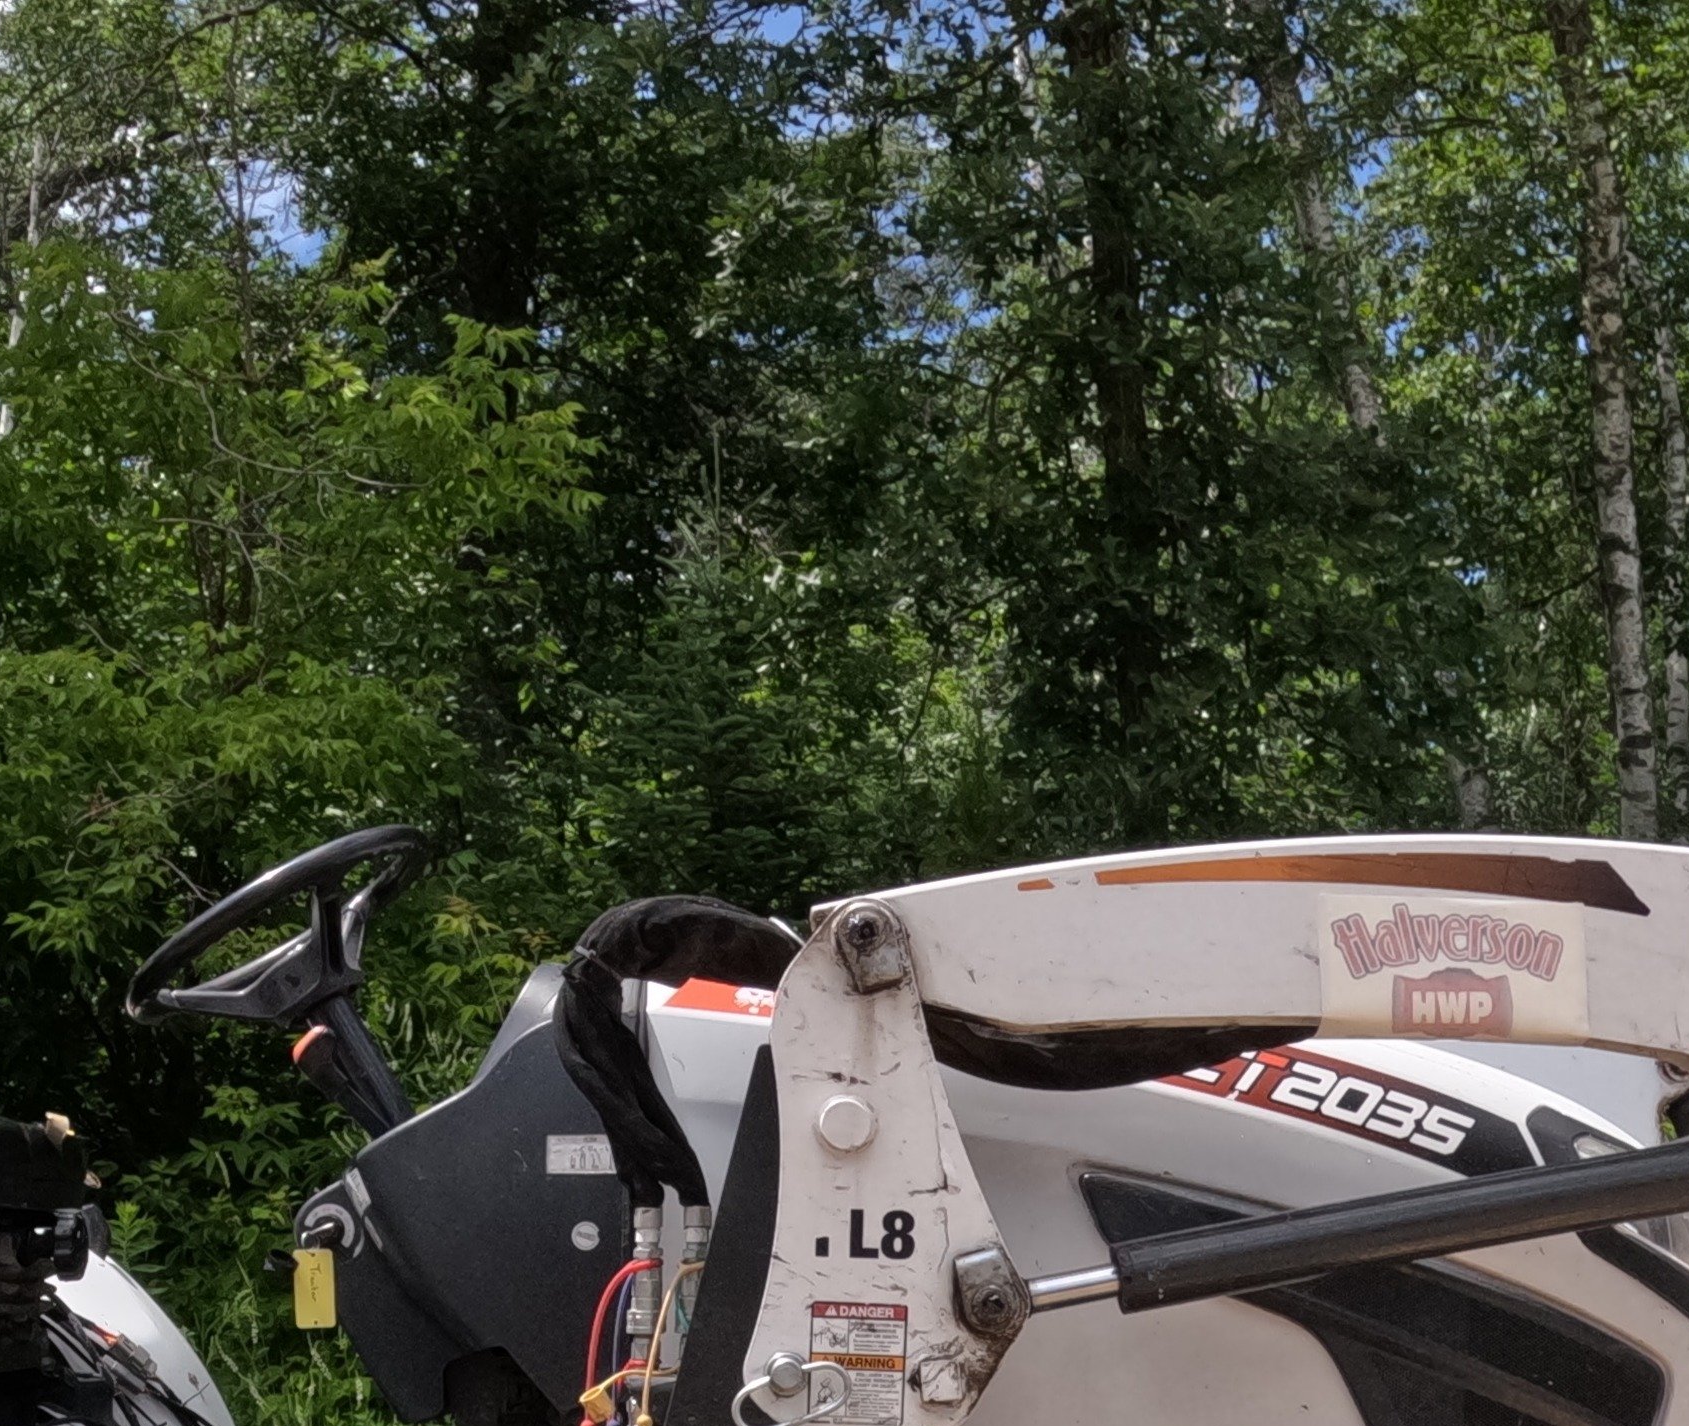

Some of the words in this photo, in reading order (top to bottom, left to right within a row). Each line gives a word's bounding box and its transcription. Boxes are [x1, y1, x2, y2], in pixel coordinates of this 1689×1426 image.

[1331, 902, 1564, 982] Halverson
[1412, 991, 1493, 1025] HWP
[839, 1305, 894, 1318] DANGER
[834, 1356, 895, 1369] WARNING
